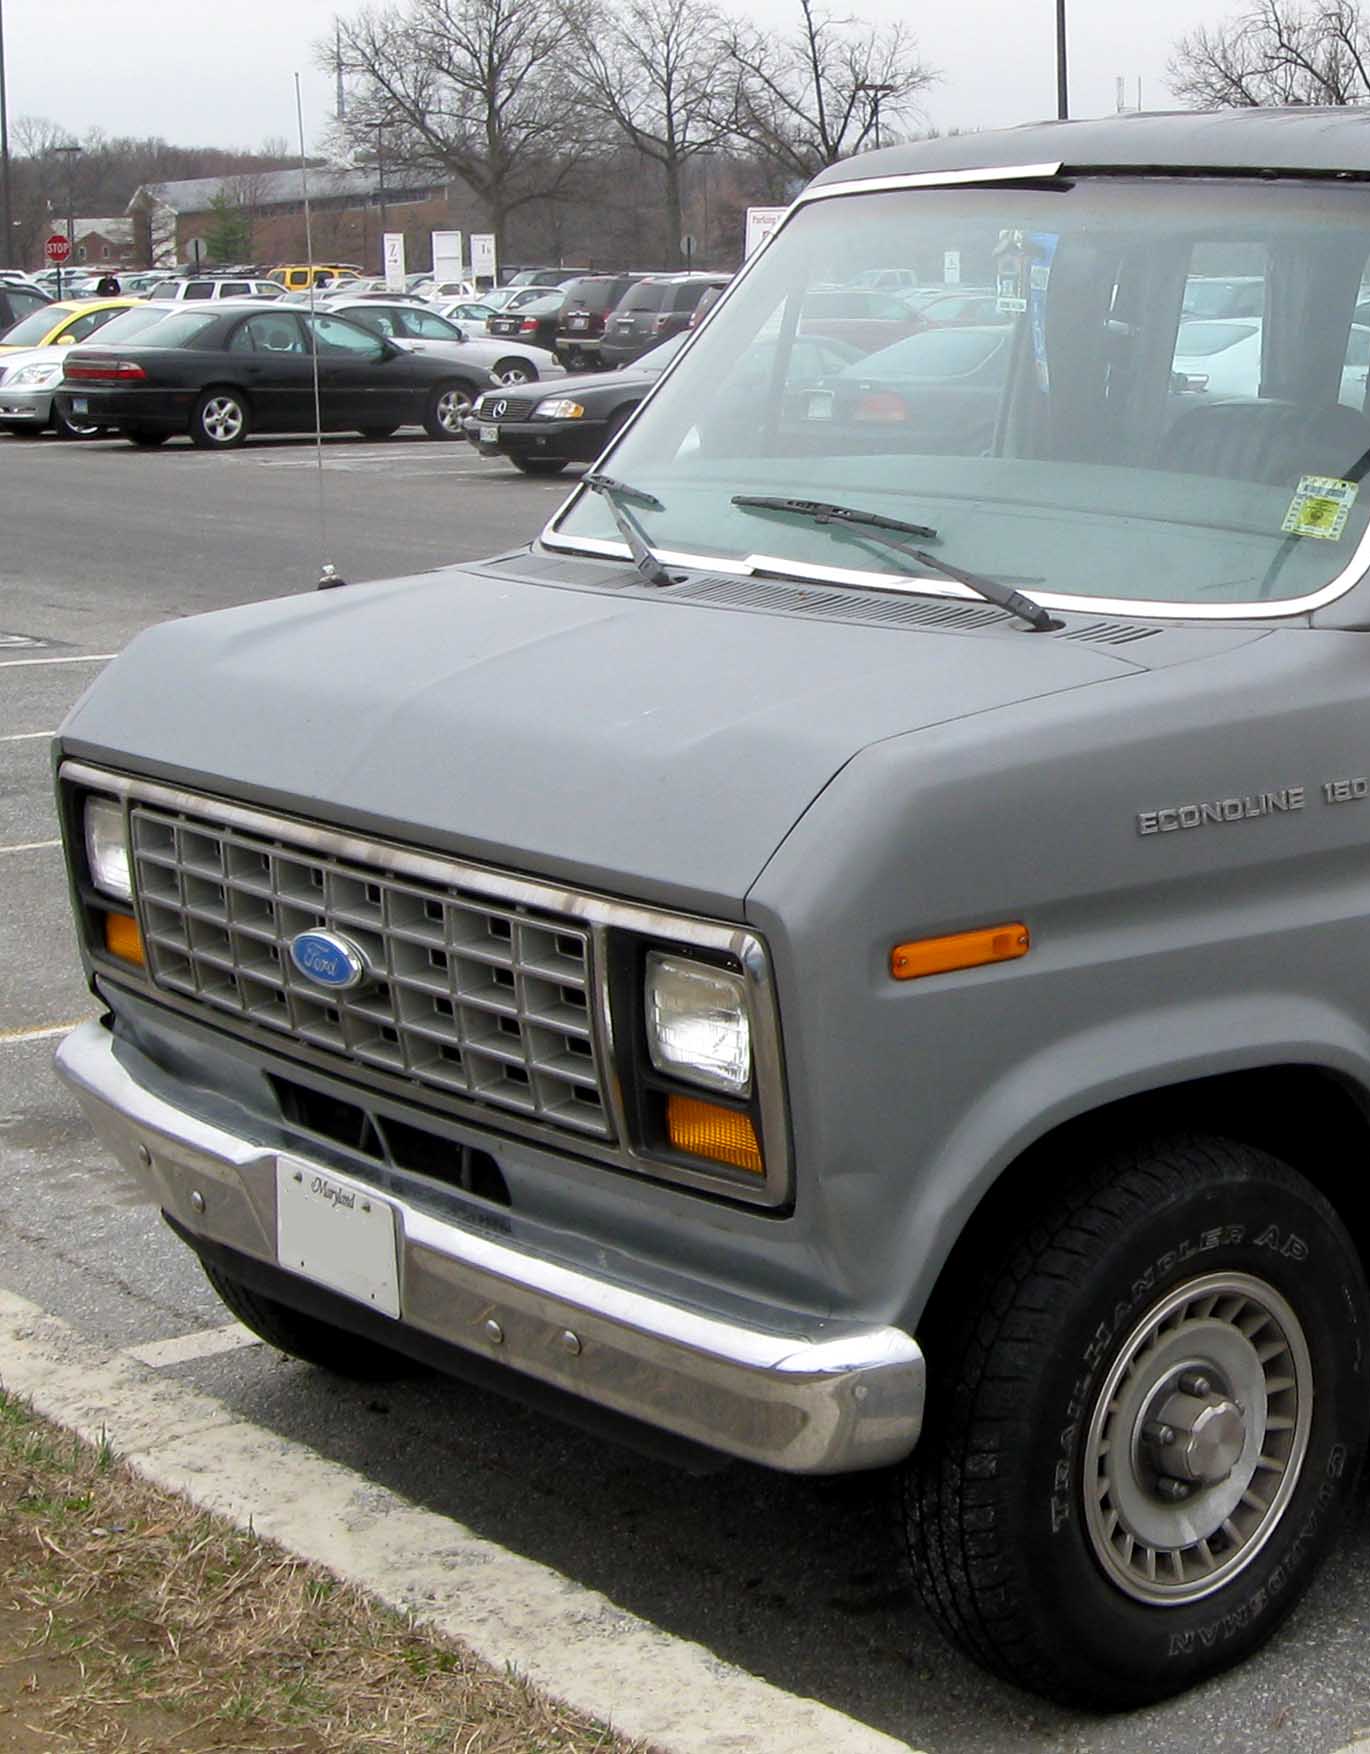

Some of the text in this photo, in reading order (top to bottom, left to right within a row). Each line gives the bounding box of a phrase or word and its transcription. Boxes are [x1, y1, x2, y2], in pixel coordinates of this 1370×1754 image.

[47, 243, 70, 254] STOP
[1138, 776, 1370, 835] ECONOLINE 150
[303, 941, 337, 977] Ford
[311, 1177, 357, 1210] Maryland
[1051, 1222, 1247, 1536] TRAILHANDLER
